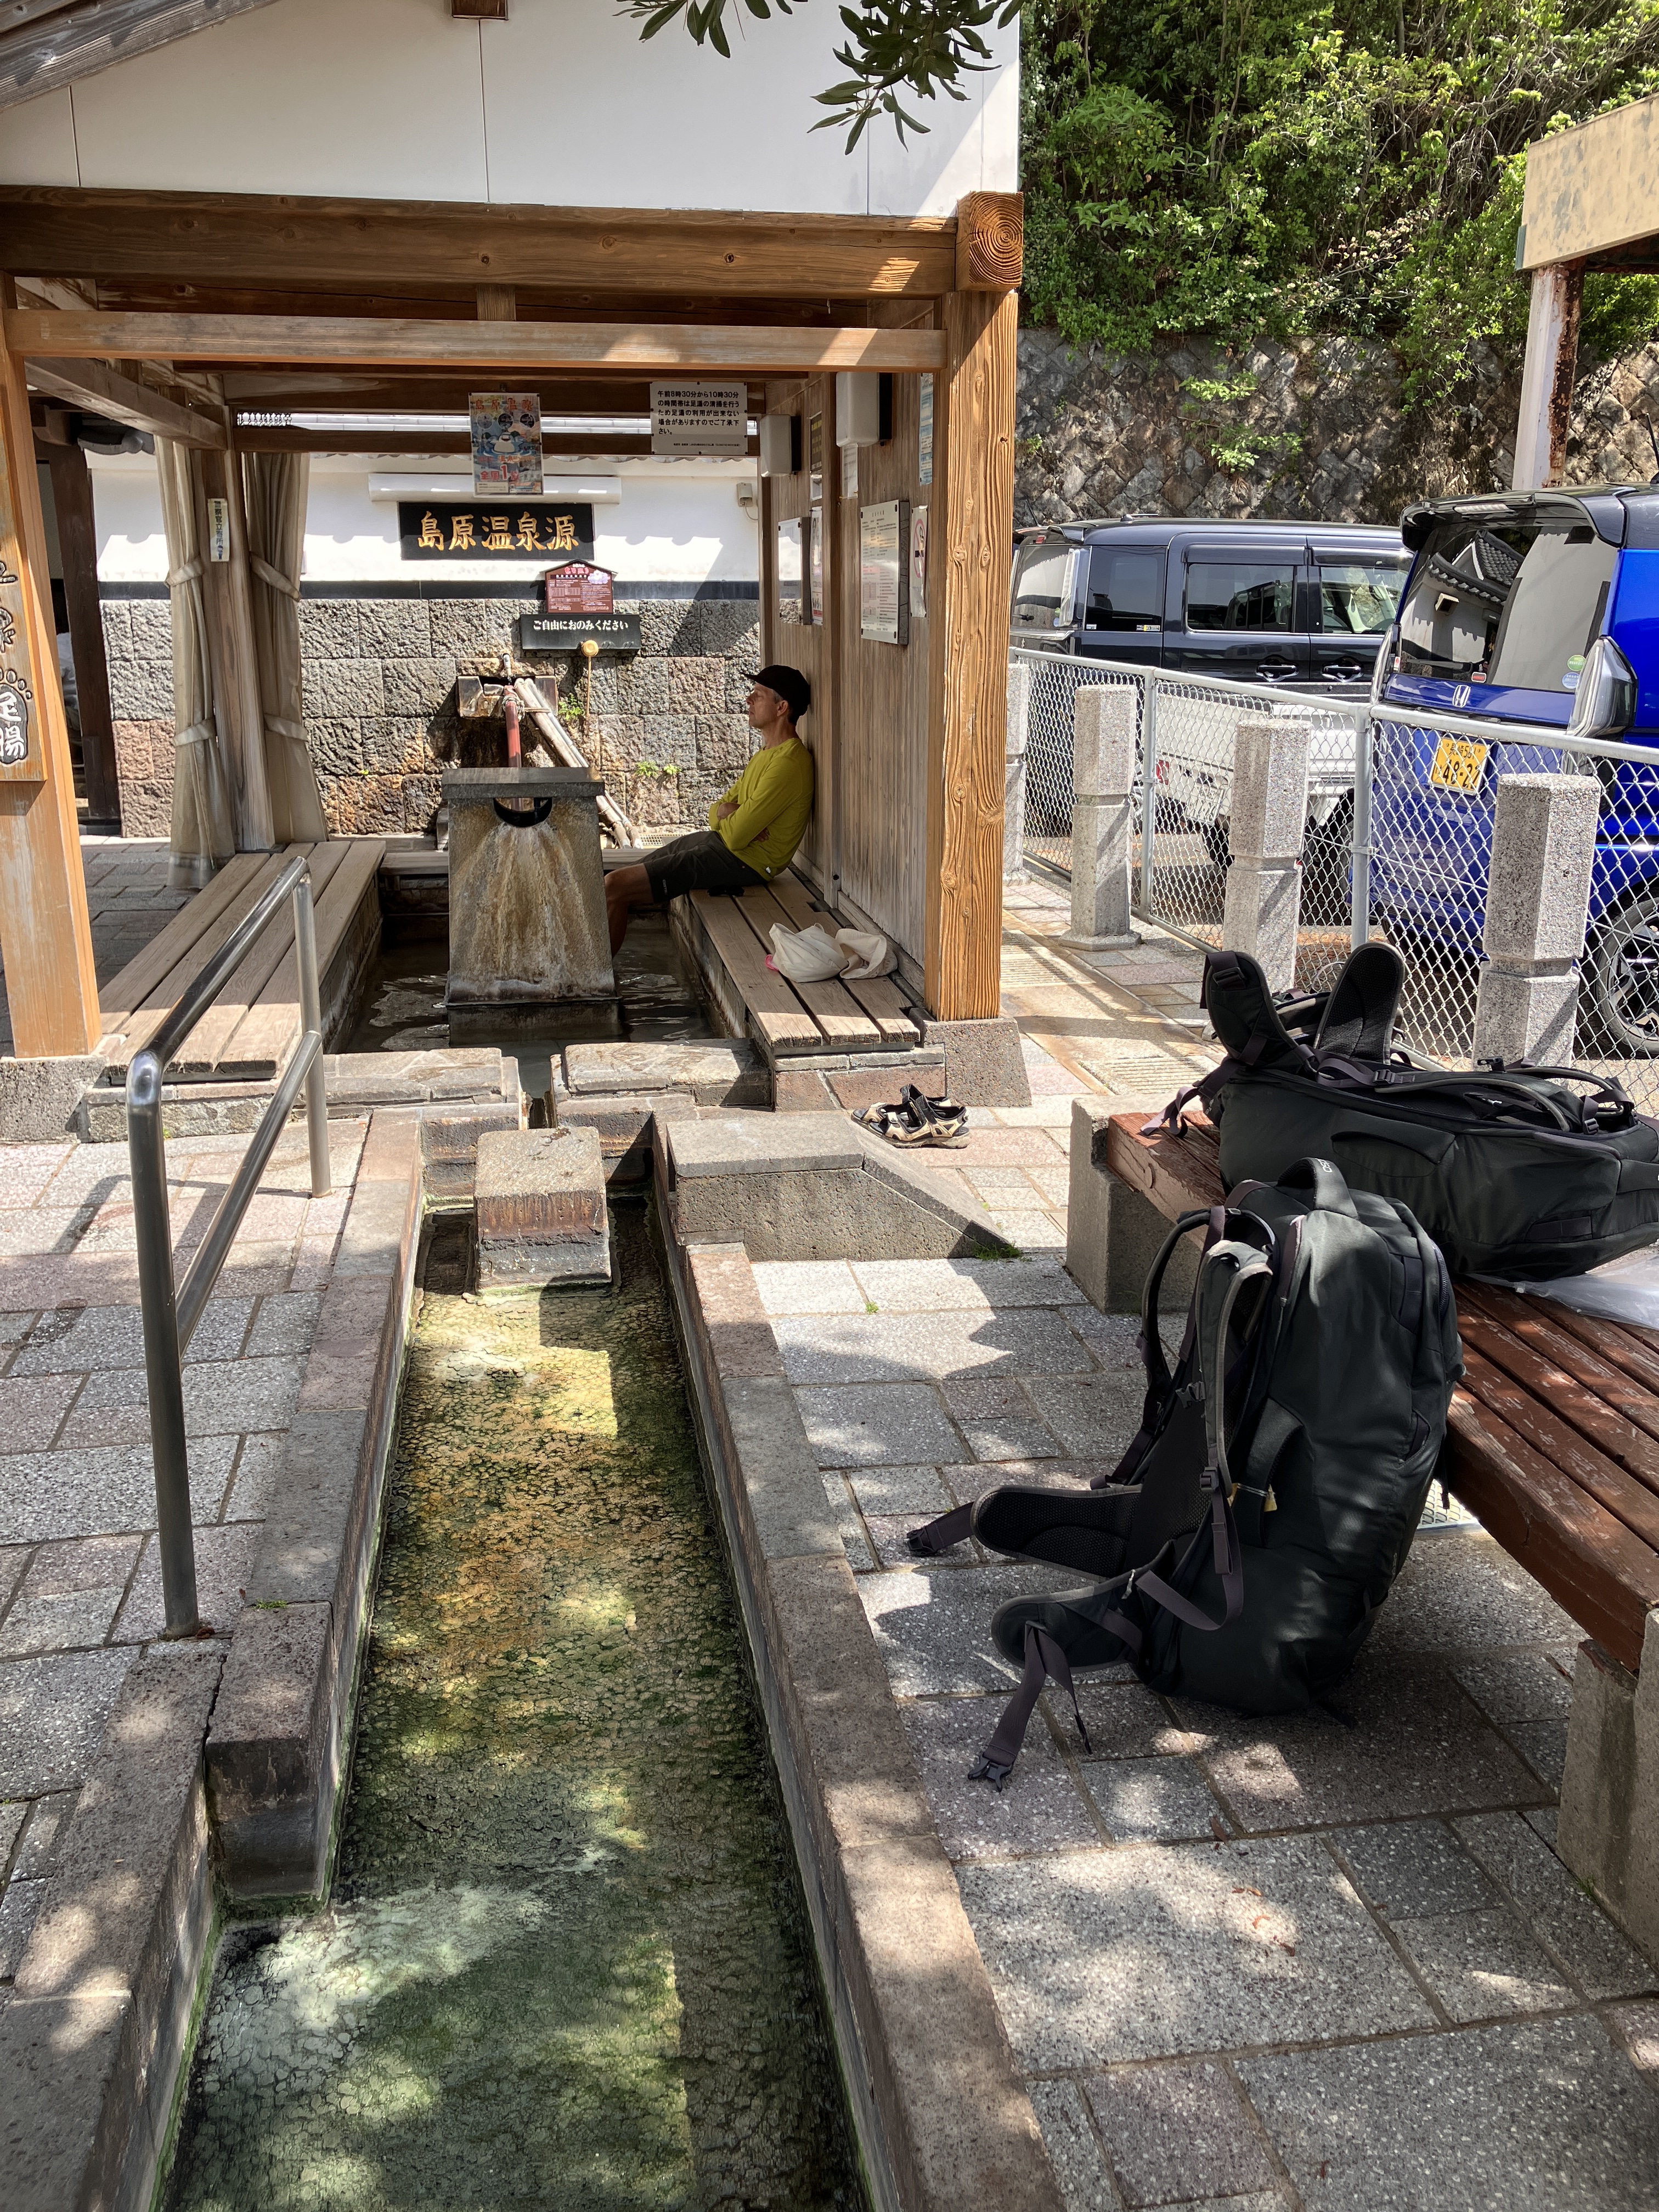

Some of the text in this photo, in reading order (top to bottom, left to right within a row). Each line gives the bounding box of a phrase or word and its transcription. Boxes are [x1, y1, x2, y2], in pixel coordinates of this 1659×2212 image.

[417, 511, 579, 551] 島原温泉源
[533, 619, 629, 630] ご自由におのみください
